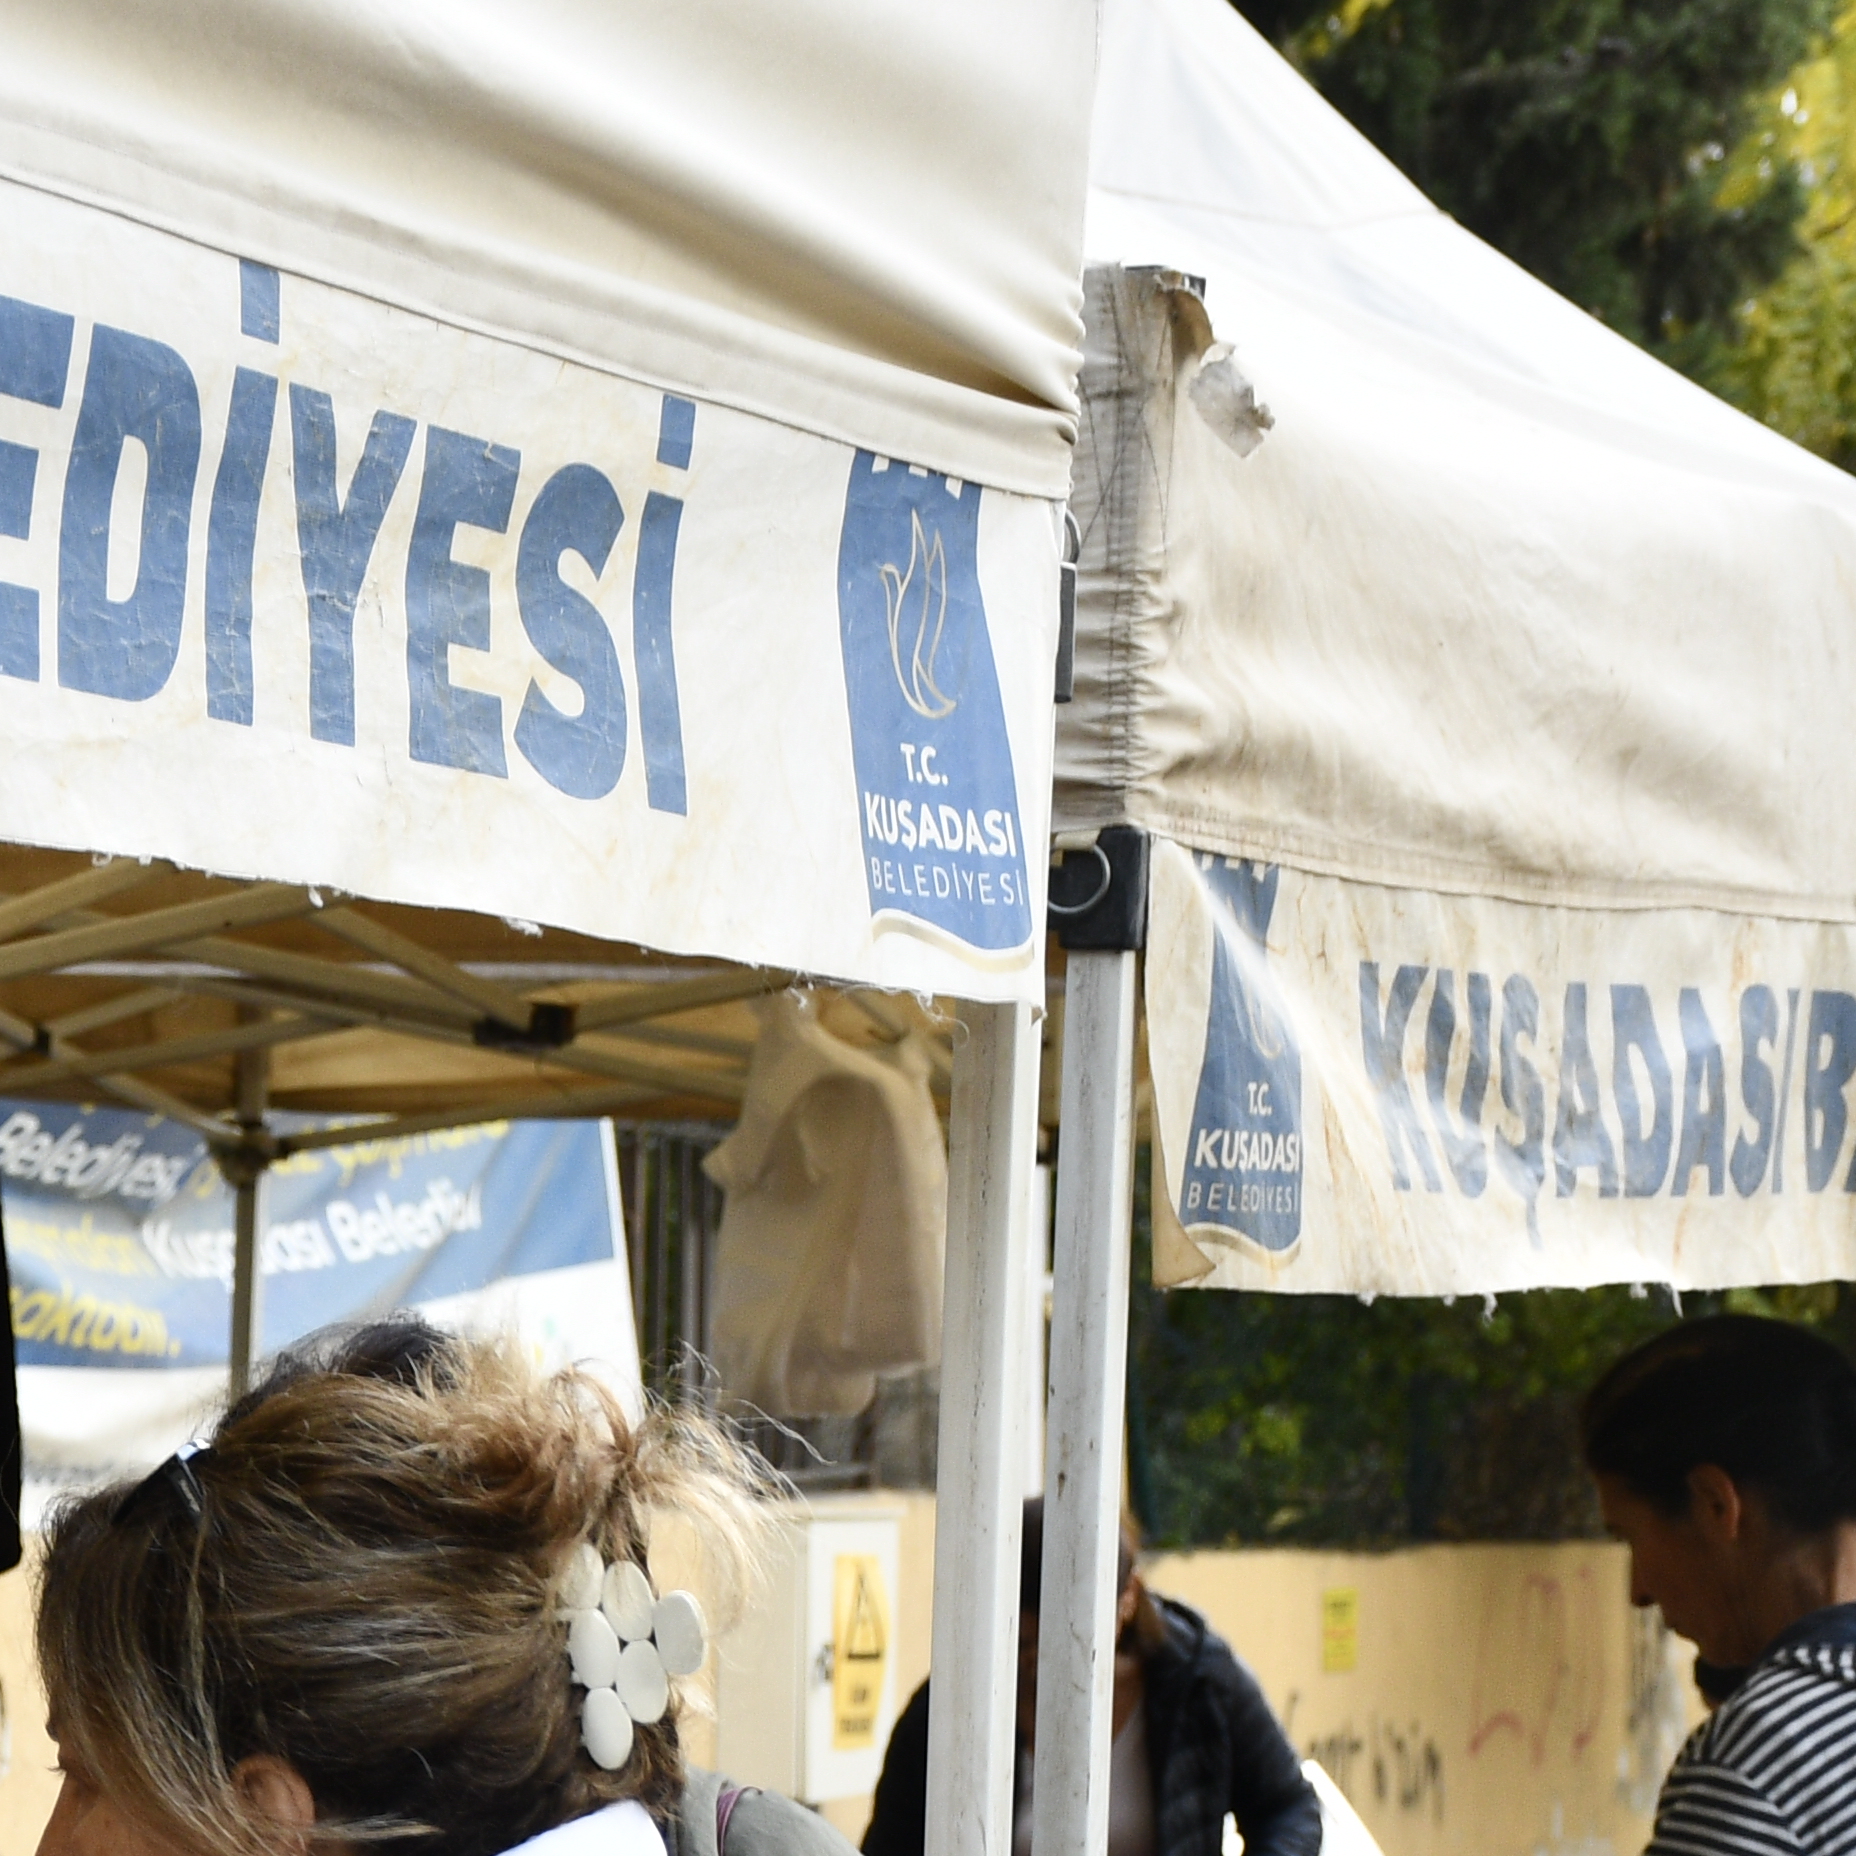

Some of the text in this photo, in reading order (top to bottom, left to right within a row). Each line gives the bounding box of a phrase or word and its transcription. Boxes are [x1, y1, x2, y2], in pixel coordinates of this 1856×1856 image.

[899, 742, 949, 787] T.C.
[863, 791, 1018, 858] KUŞADASI
[870, 856, 1025, 906] BELEDİYESİ
[1247, 1081, 1273, 1116] T.C.
[1359, 960, 1800, 1250] KUŞADASI
[1193, 1128, 1301, 1173] KUŞADASI
[1187, 1180, 1299, 1213] BELEDİYESİ
